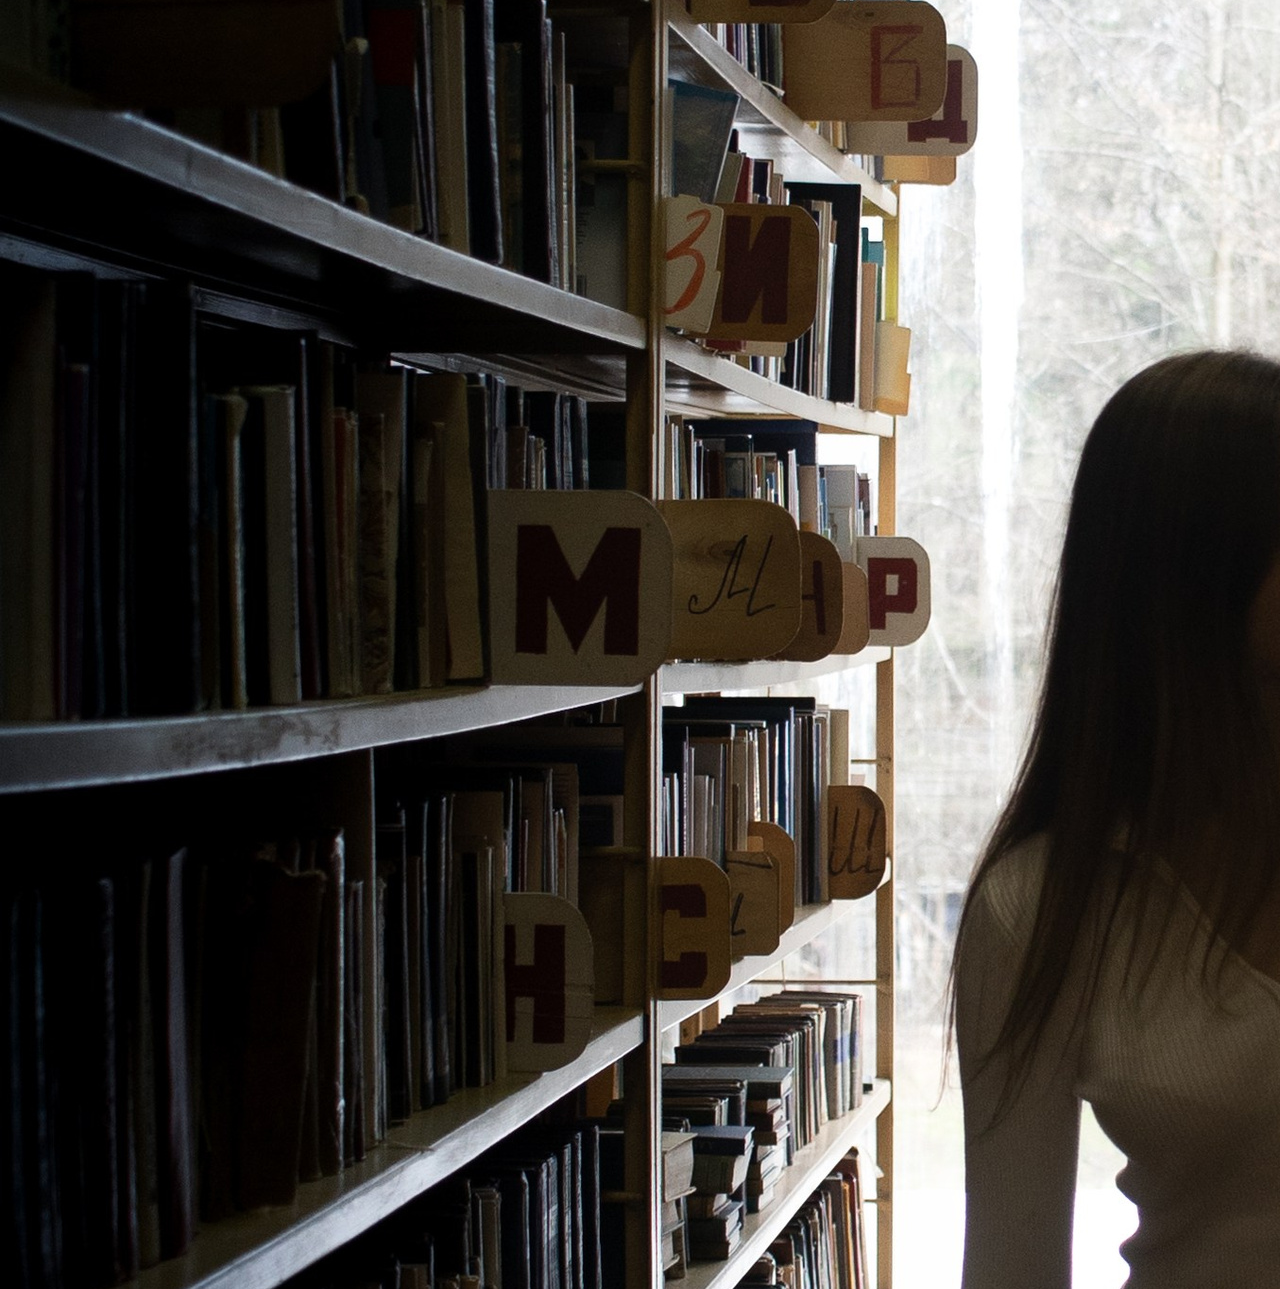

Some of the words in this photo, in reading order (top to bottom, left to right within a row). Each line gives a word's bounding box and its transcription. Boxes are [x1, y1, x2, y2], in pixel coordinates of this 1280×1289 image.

[870, 25, 923, 110] Б
[722, 214, 791, 324] И
[515, 524, 642, 655] М
[868, 557, 918, 630] Р
[506, 924, 565, 1043] Н
